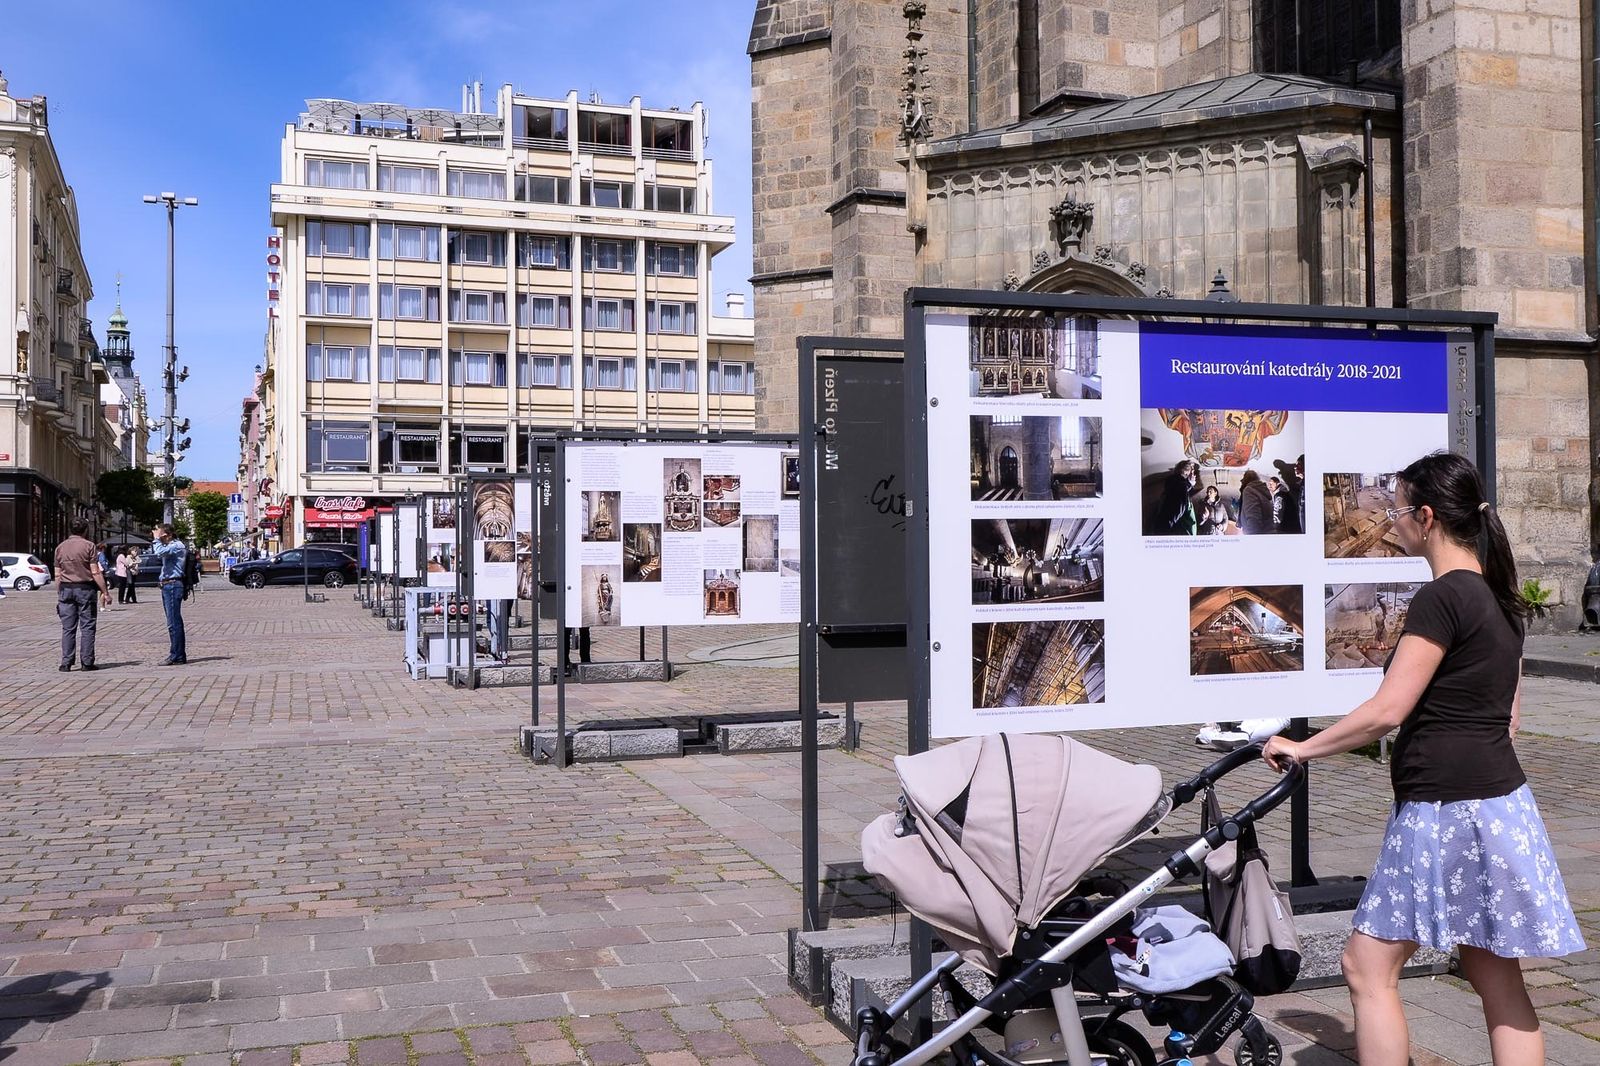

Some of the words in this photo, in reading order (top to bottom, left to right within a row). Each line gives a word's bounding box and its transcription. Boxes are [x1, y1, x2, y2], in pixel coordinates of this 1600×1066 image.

[267, 236, 280, 318] HOTEL
[1170, 358, 1265, 376] Restaurování
[1269, 360, 1334, 381] katedrály
[1215, 1008, 1242, 1037] Lascal
